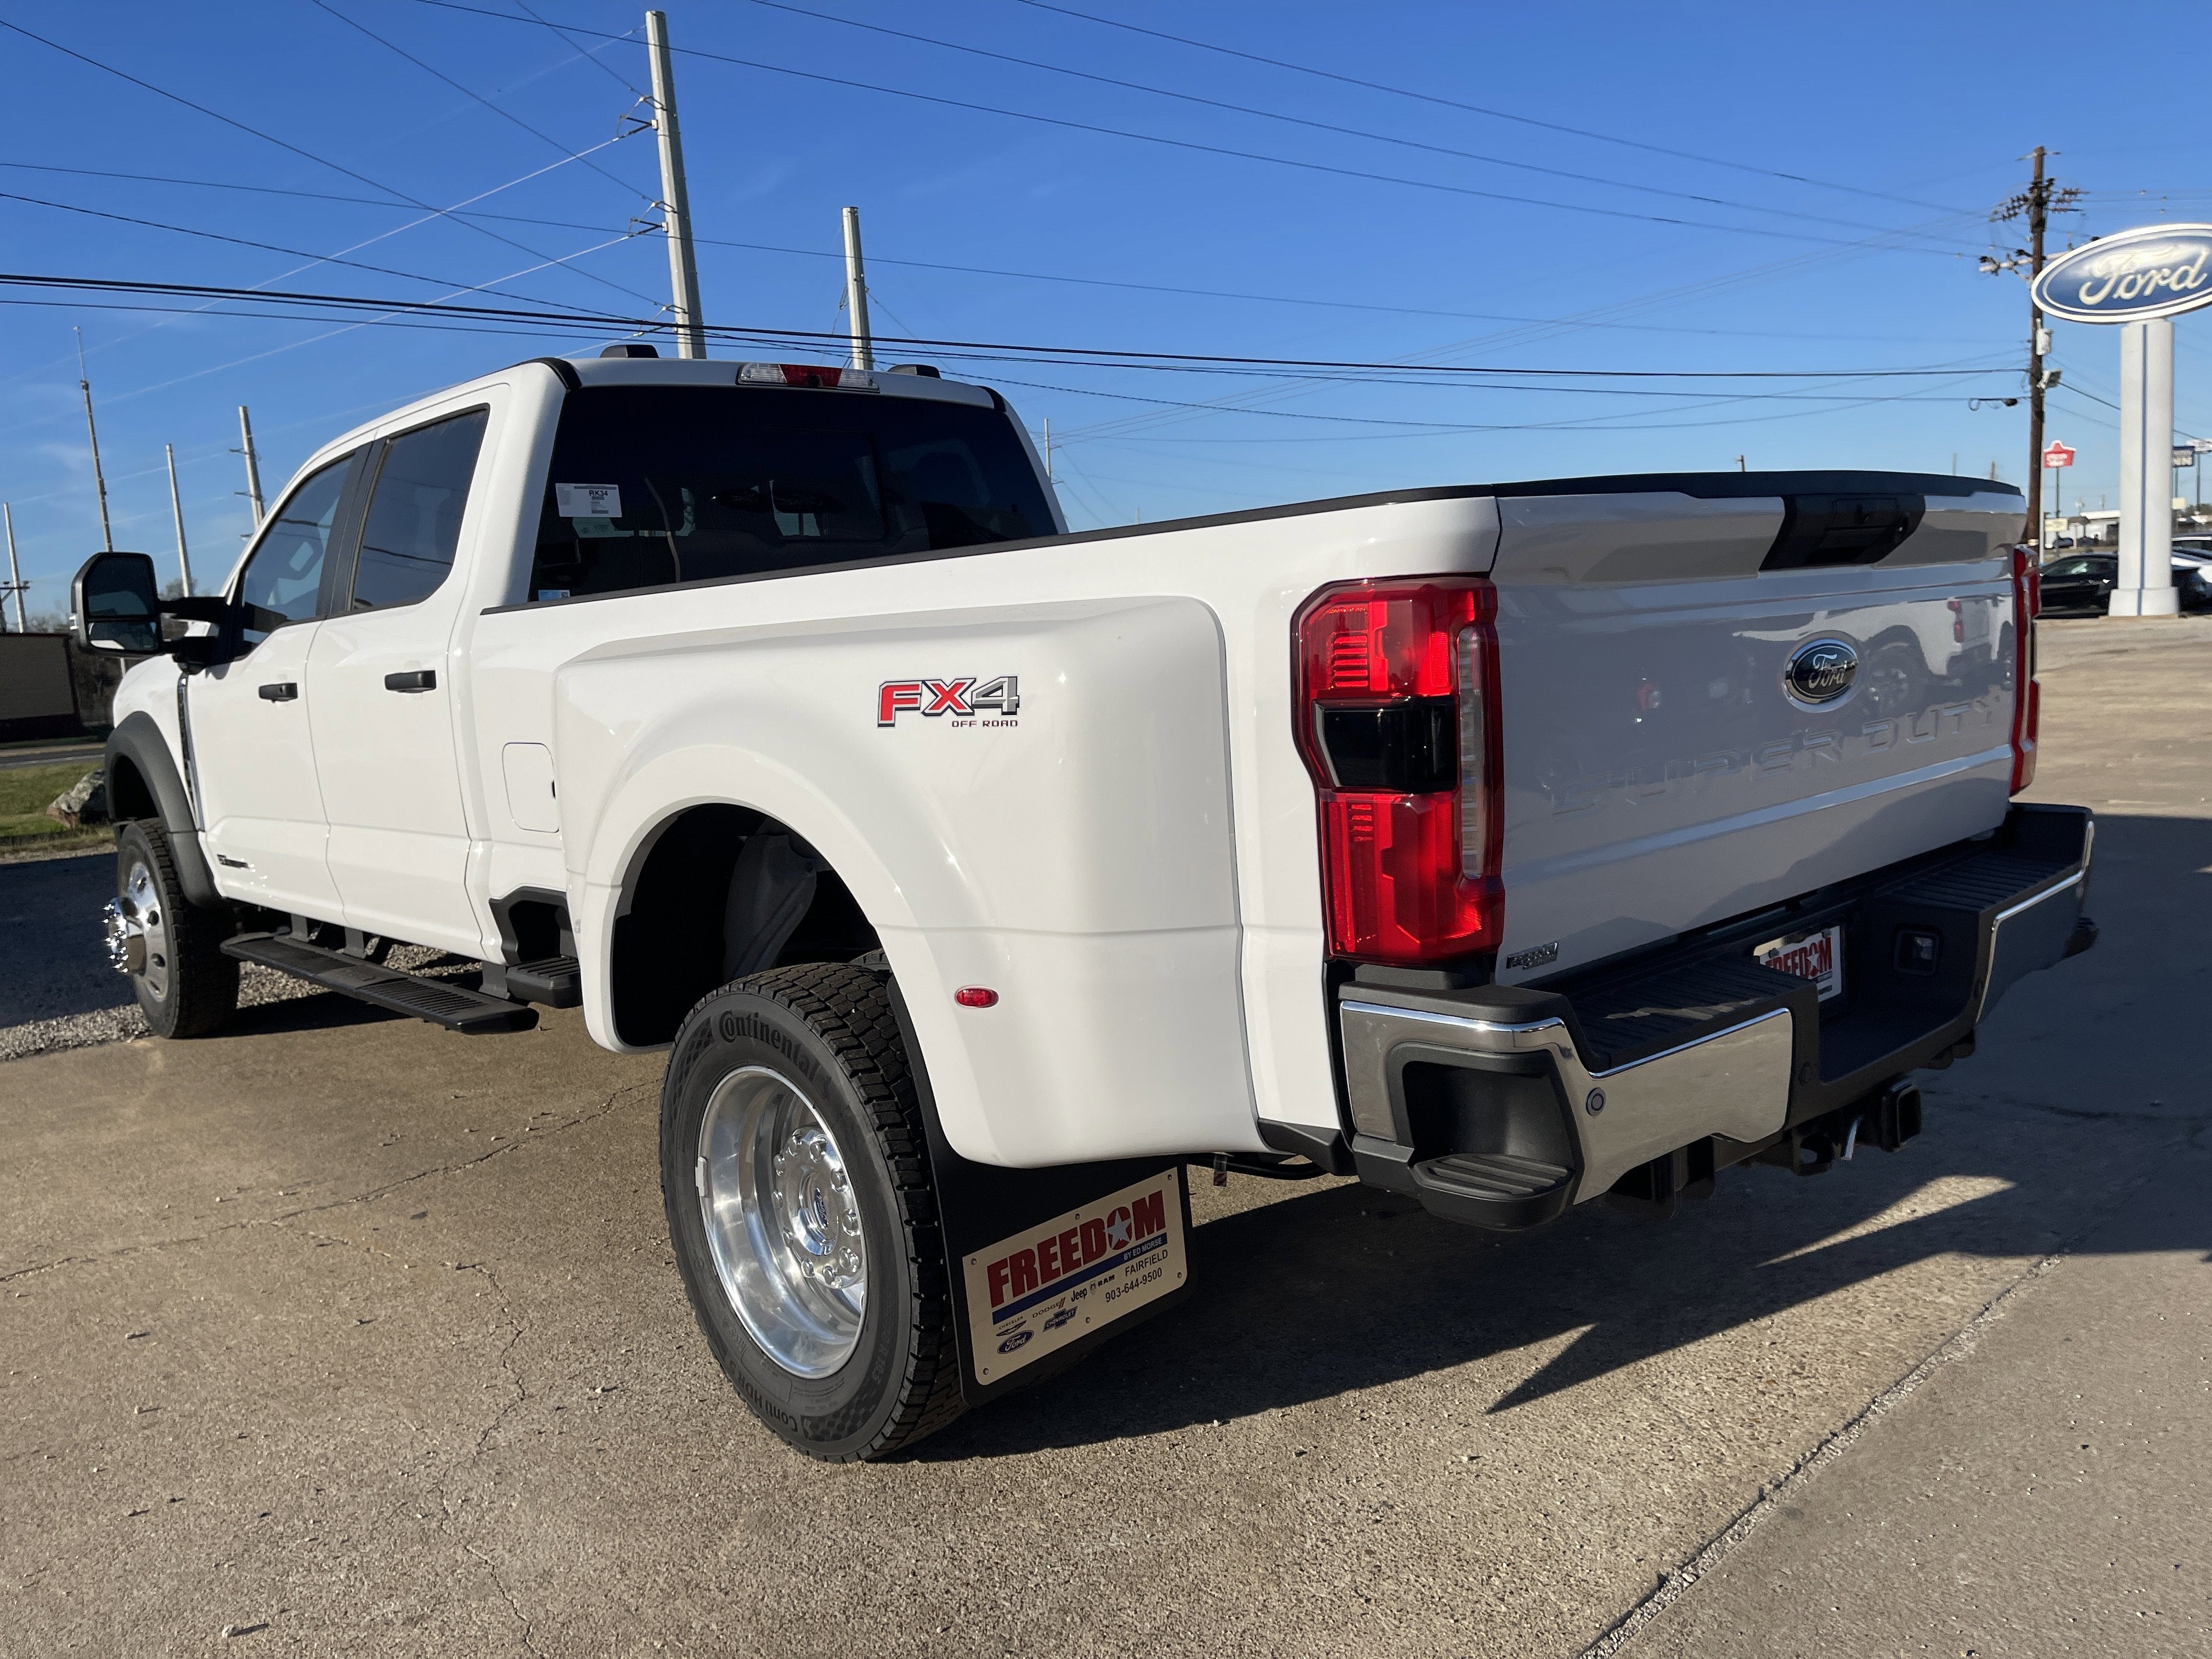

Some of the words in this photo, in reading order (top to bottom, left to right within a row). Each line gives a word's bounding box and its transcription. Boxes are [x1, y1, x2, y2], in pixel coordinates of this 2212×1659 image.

[2079, 246, 2210, 306] Ford
[1808, 653, 1847, 689] Ford
[877, 675, 1020, 727] FX4
[1551, 728, 1847, 819] SUPER
[1861, 696, 2001, 755] DUTY
[719, 1010, 821, 1084] Continental
[987, 1189, 1166, 1308] FREEDOM
[1124, 1252, 1132, 1261] BY
[1133, 1248, 1141, 1256] ED
[1141, 1237, 1163, 1252] MORSE
[1125, 1249, 1168, 1277] FAIRFIELD
[1071, 1288, 1087, 1302] Jeep
[1098, 1274, 1115, 1287] RAM
[1105, 1267, 1163, 1303] 903-644-9500
[1005, 1334, 1027, 1352] Ford
